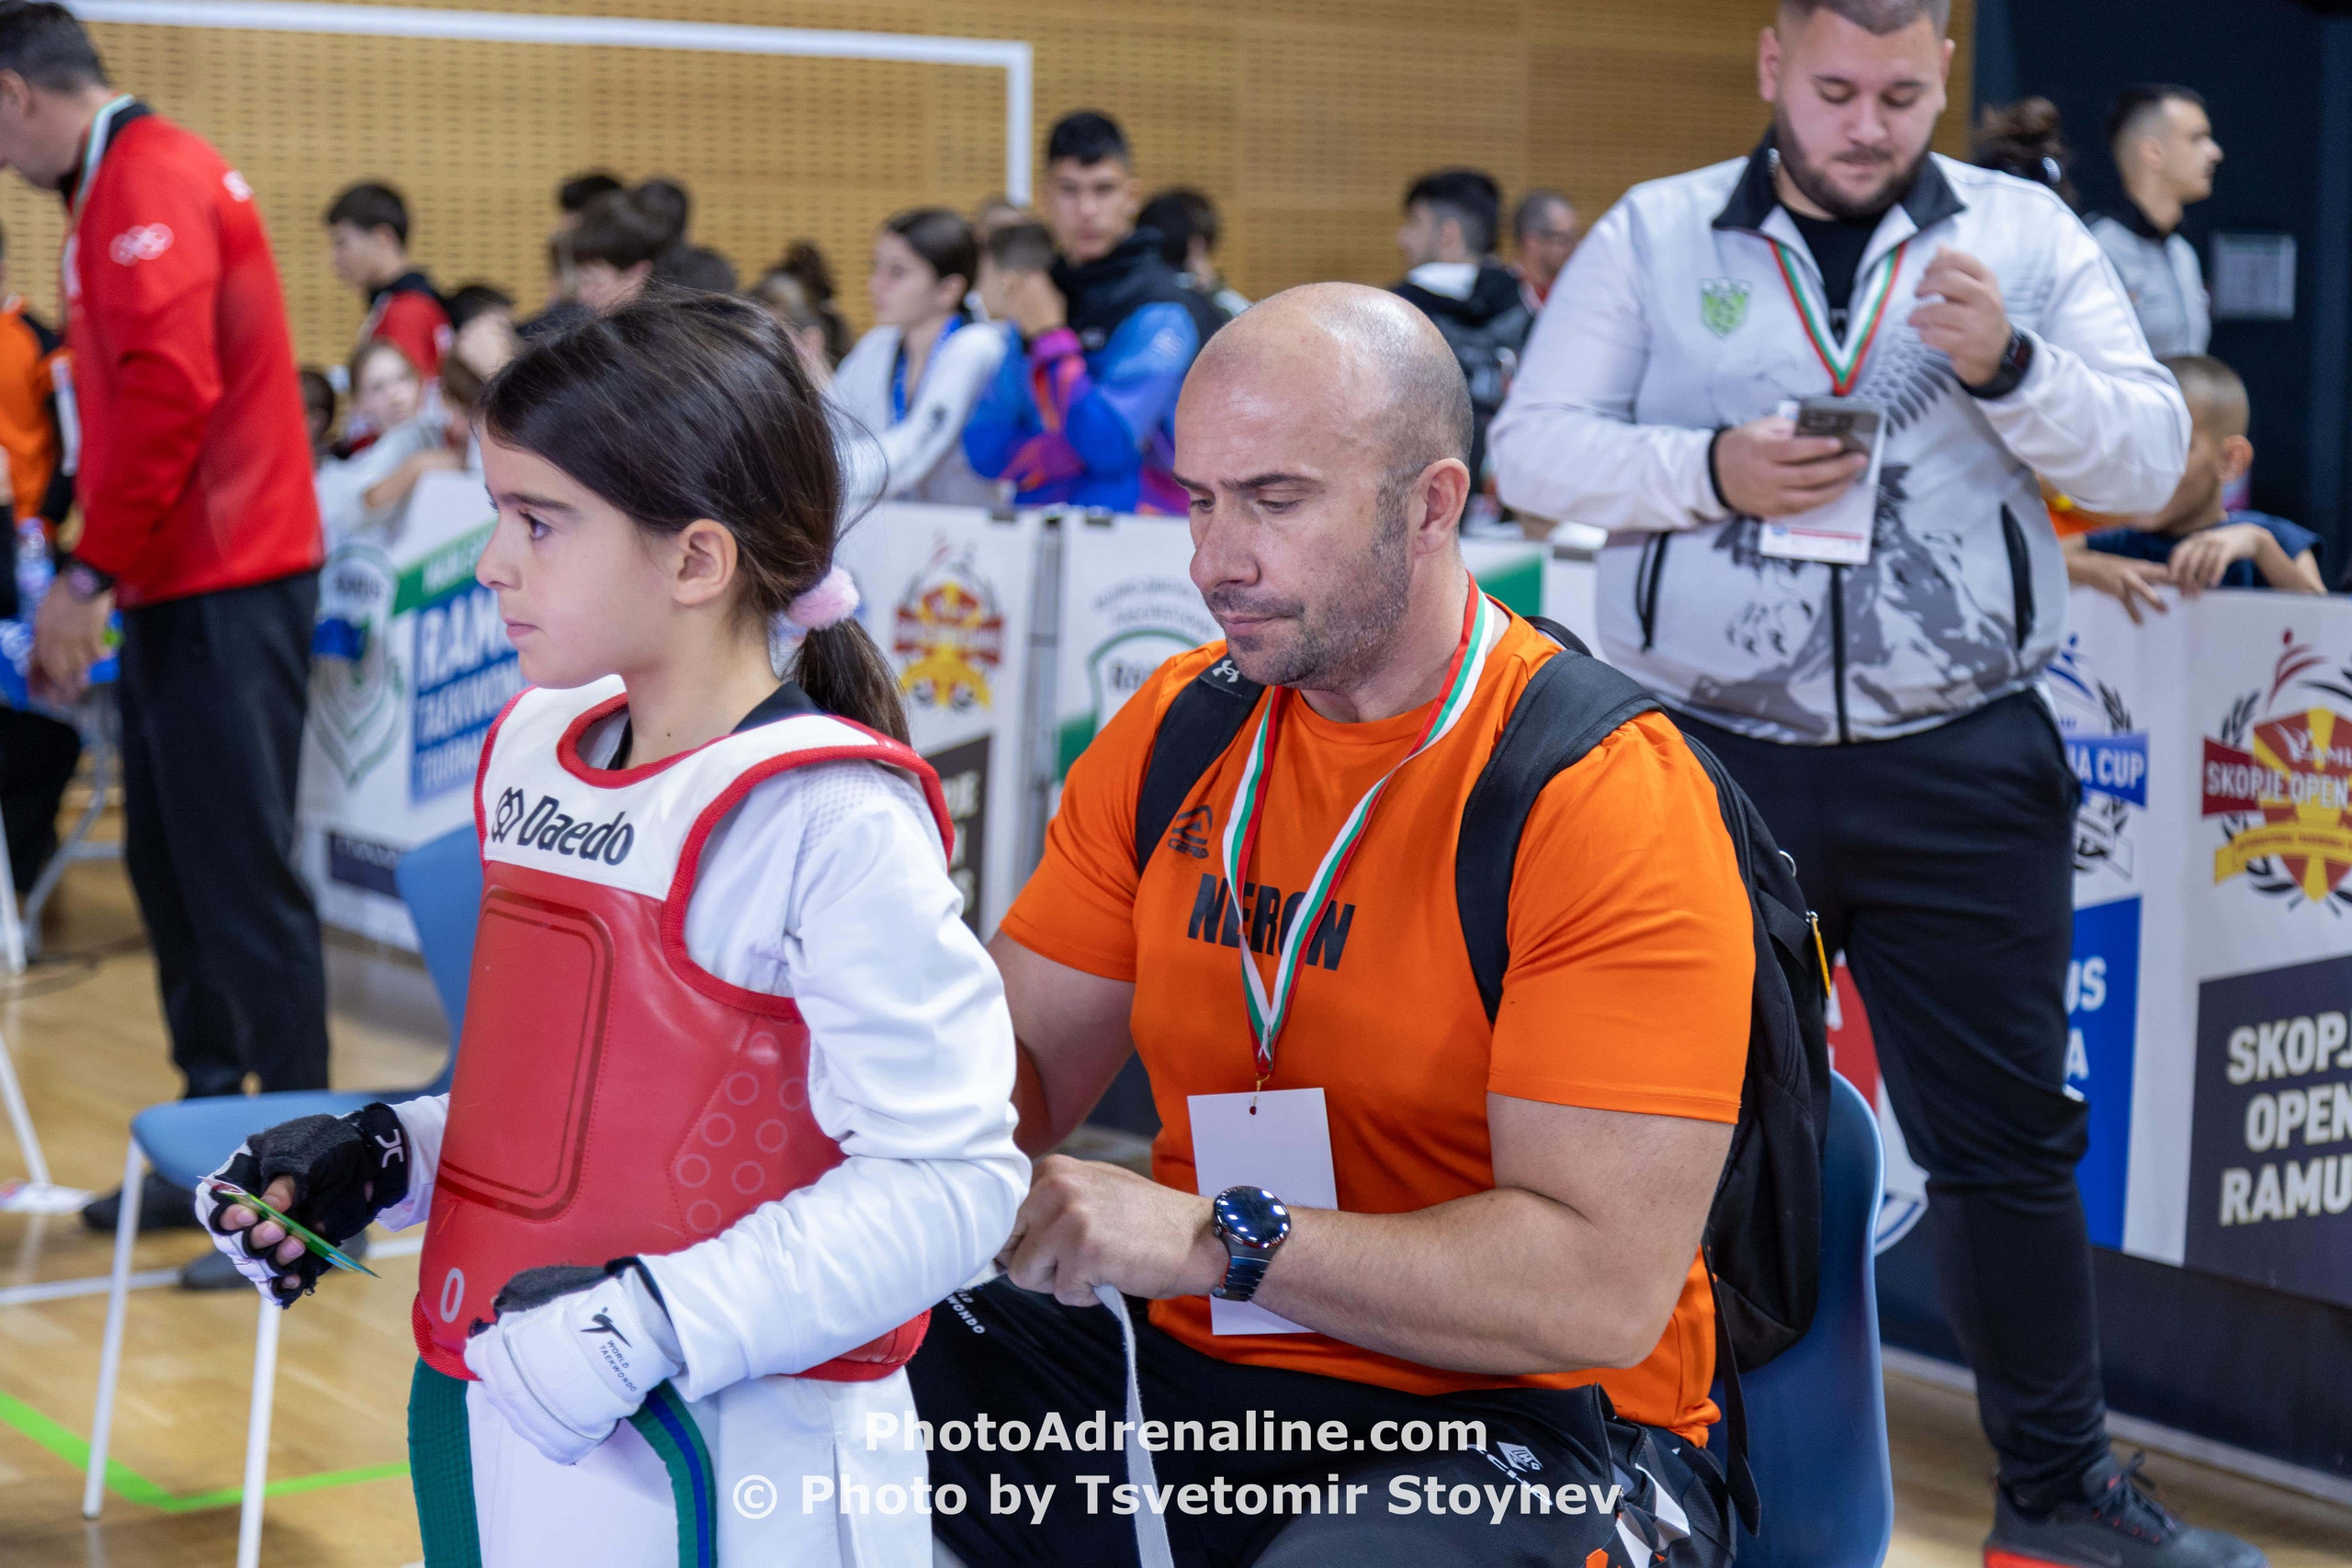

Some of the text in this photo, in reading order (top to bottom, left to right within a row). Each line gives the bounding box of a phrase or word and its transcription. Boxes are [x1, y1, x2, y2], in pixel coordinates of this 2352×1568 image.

[2097, 746, 2144, 789] CUP
[2207, 760, 2348, 810] SKOPJE OPEN
[516, 795, 635, 866] Daedo
[598, 1345, 638, 1393] TAEKWONDO
[606, 1339, 629, 1369] WORLD
